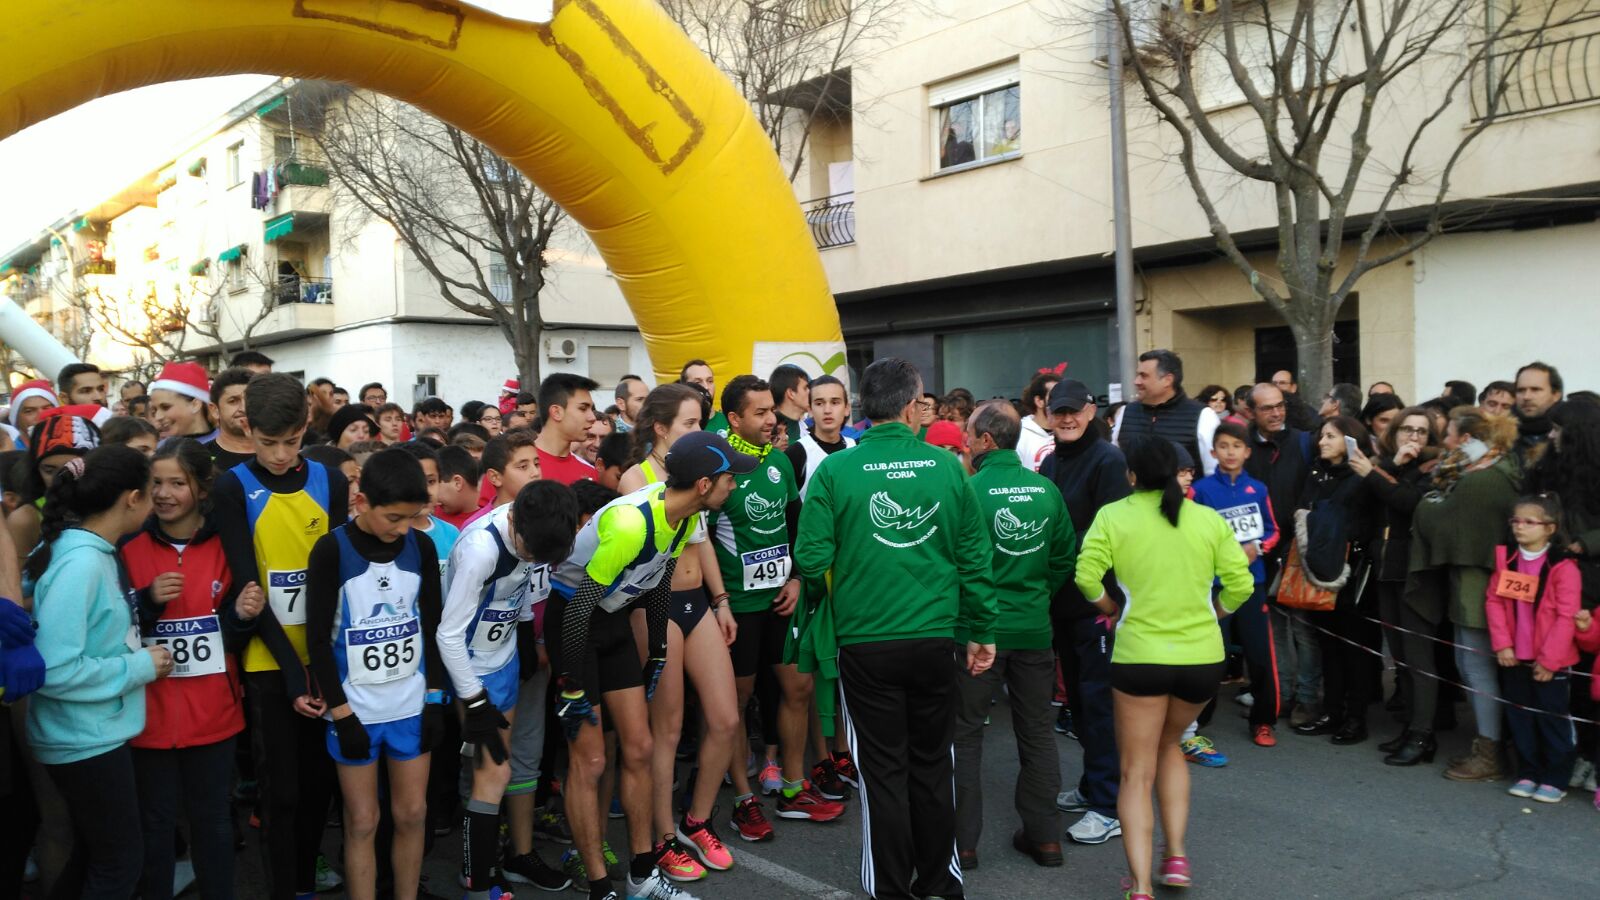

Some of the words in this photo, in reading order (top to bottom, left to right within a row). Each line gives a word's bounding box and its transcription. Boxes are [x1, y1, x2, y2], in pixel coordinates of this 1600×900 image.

[863, 463, 887, 471] CLUB
[888, 460, 936, 470] ATLETISMO
[886, 471, 916, 479] CORIA
[989, 487, 1009, 495] CLUB
[1010, 486, 1045, 494] ATLETISMO
[754, 548, 782, 561] CORIA
[753, 558, 786, 581] 497
[1505, 579, 1531, 593] 734
[156, 621, 203, 633] CORIA
[365, 624, 410, 640] CORIA
[155, 635, 211, 664] 86
[362, 637, 415, 671] 685
